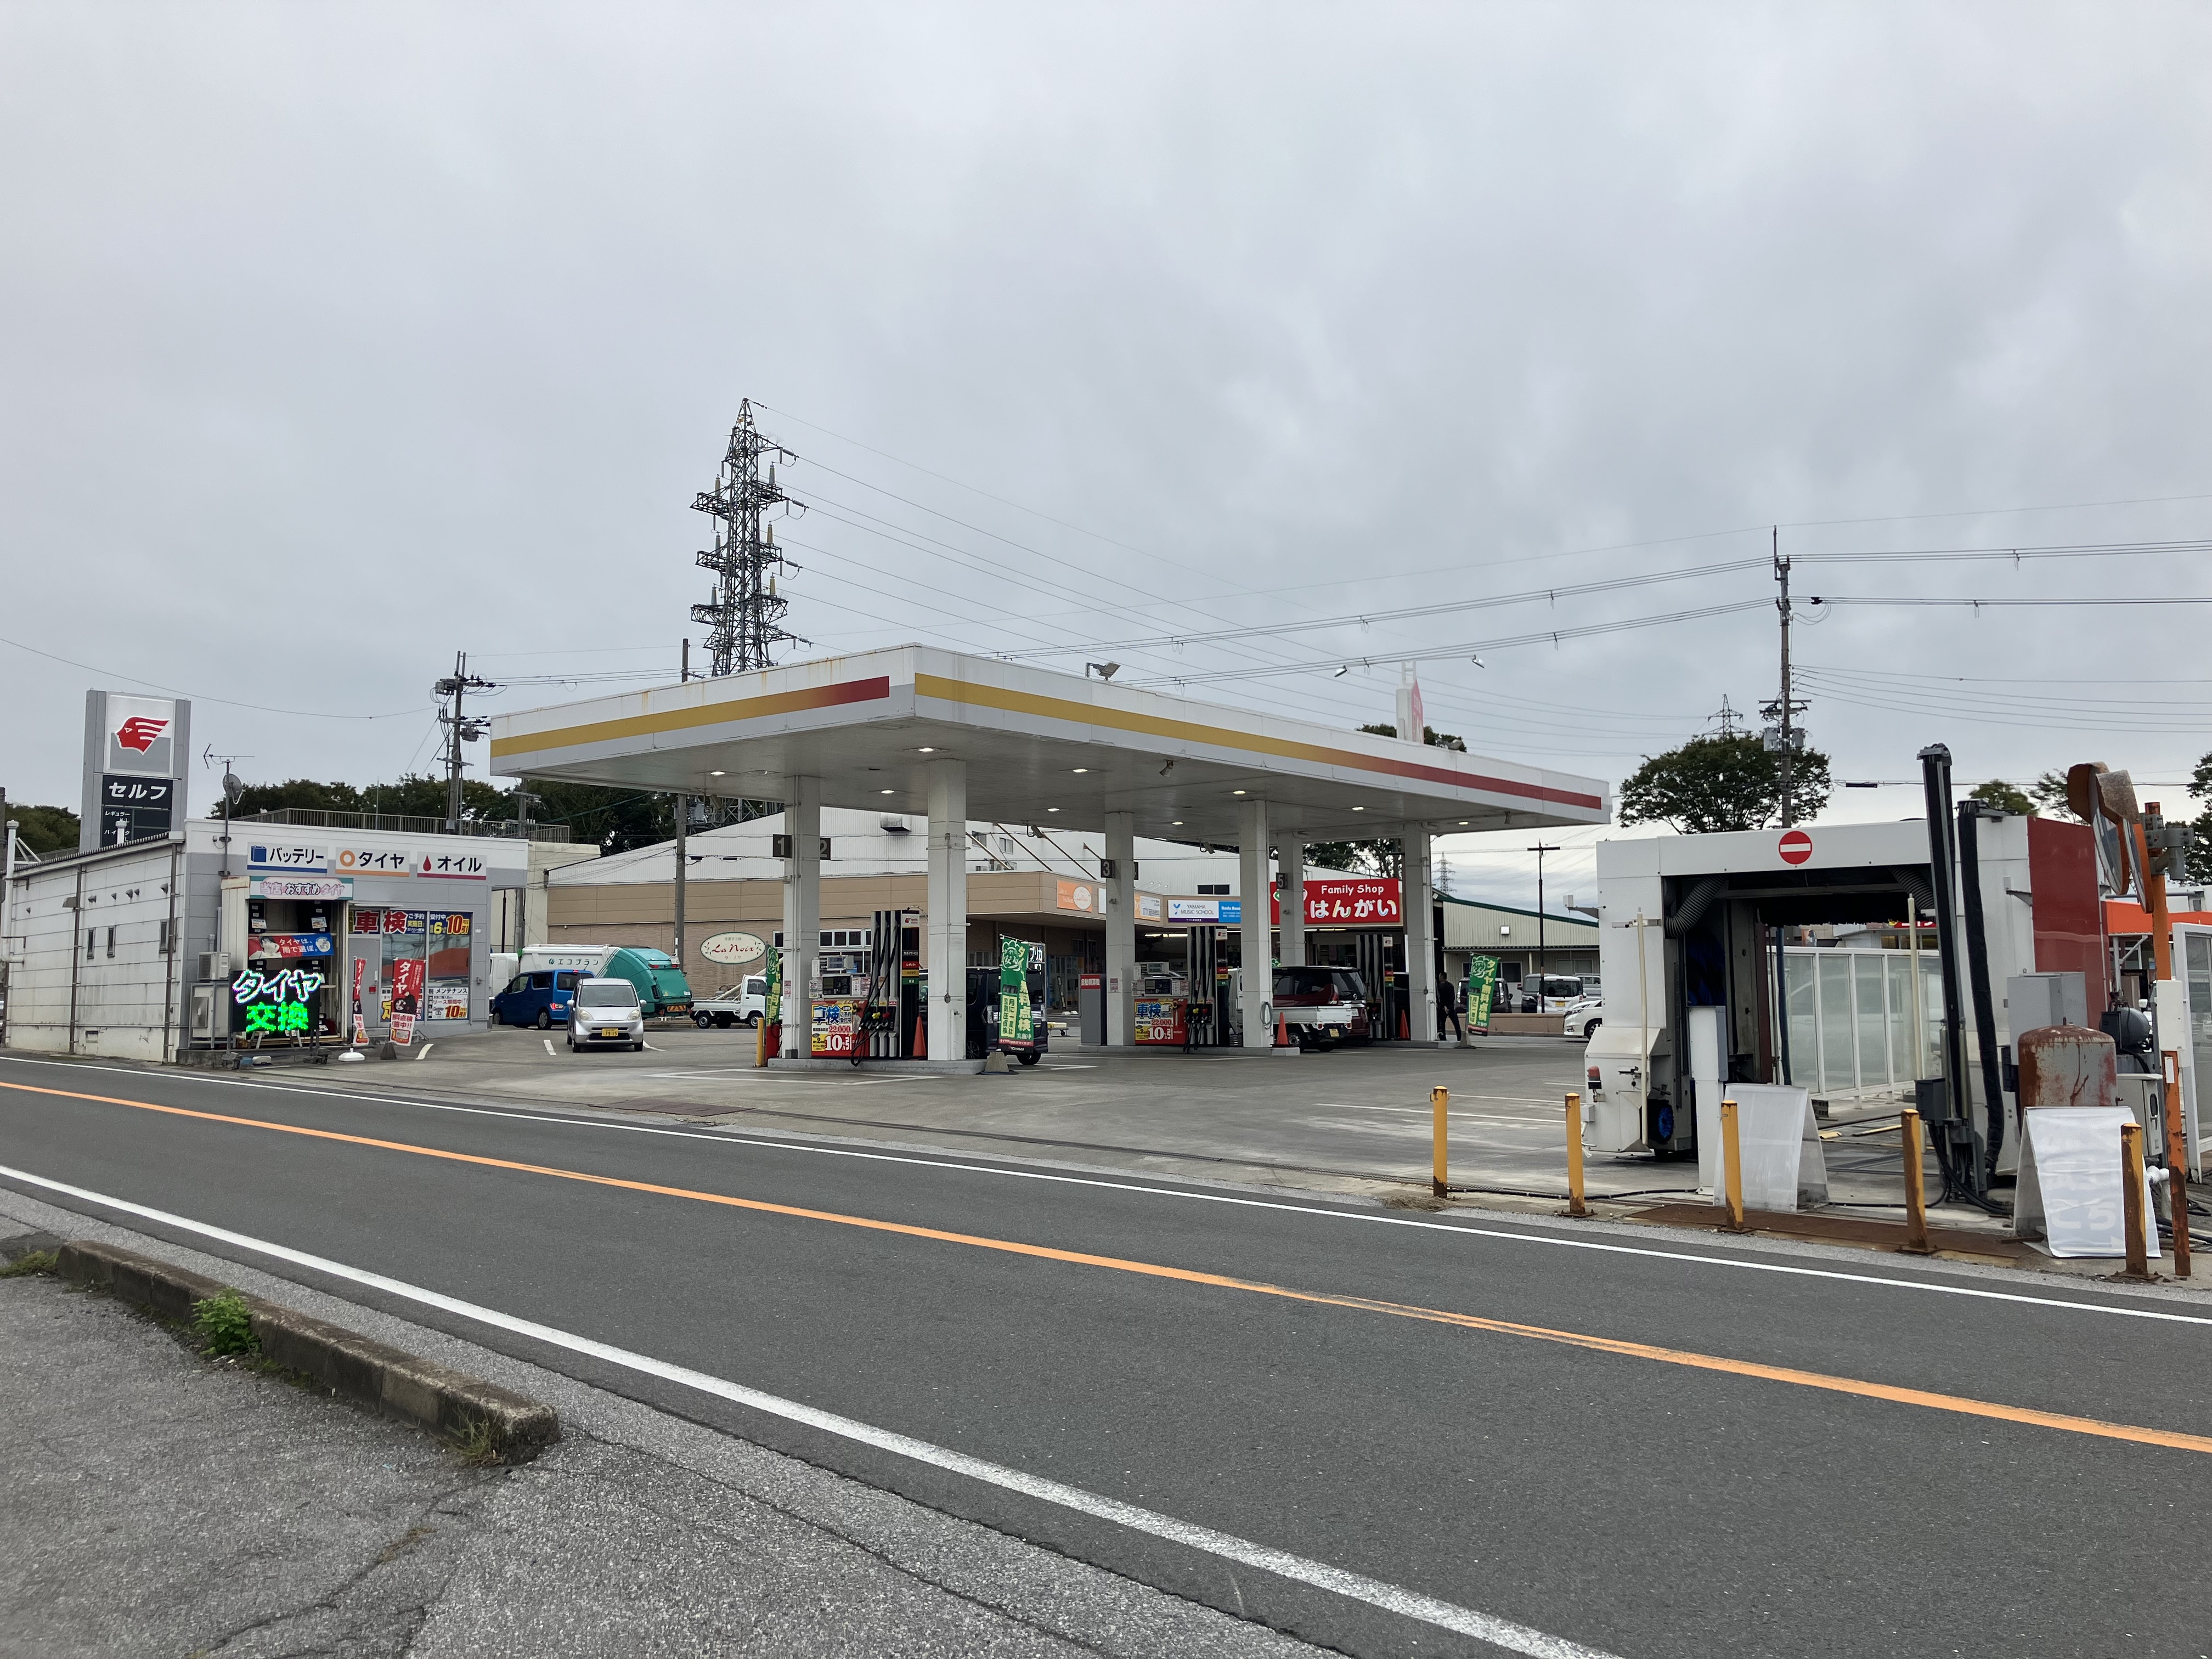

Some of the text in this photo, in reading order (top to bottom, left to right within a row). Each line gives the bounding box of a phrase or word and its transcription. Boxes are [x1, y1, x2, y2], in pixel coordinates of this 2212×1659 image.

[109, 782, 167, 800] セルフ
[777, 837, 785, 856] 1
[820, 839, 827, 857] 2
[269, 847, 324, 864] バッテリー
[358, 851, 404, 868] タイヤ
[437, 856, 482, 872] オイル
[1103, 861, 1110, 877] 3
[1278, 876, 1284, 888] 5
[1321, 884, 1384, 896] Family Shop
[1310, 899, 1397, 918] はんがい
[354, 910, 408, 934] 車検
[712, 944, 754, 953] La Noix
[396, 961, 411, 994] タイヤ
[233, 968, 321, 1005] タイヤ
[246, 1001, 309, 1032] 交換
[1136, 1003, 1161, 1018] 車検
